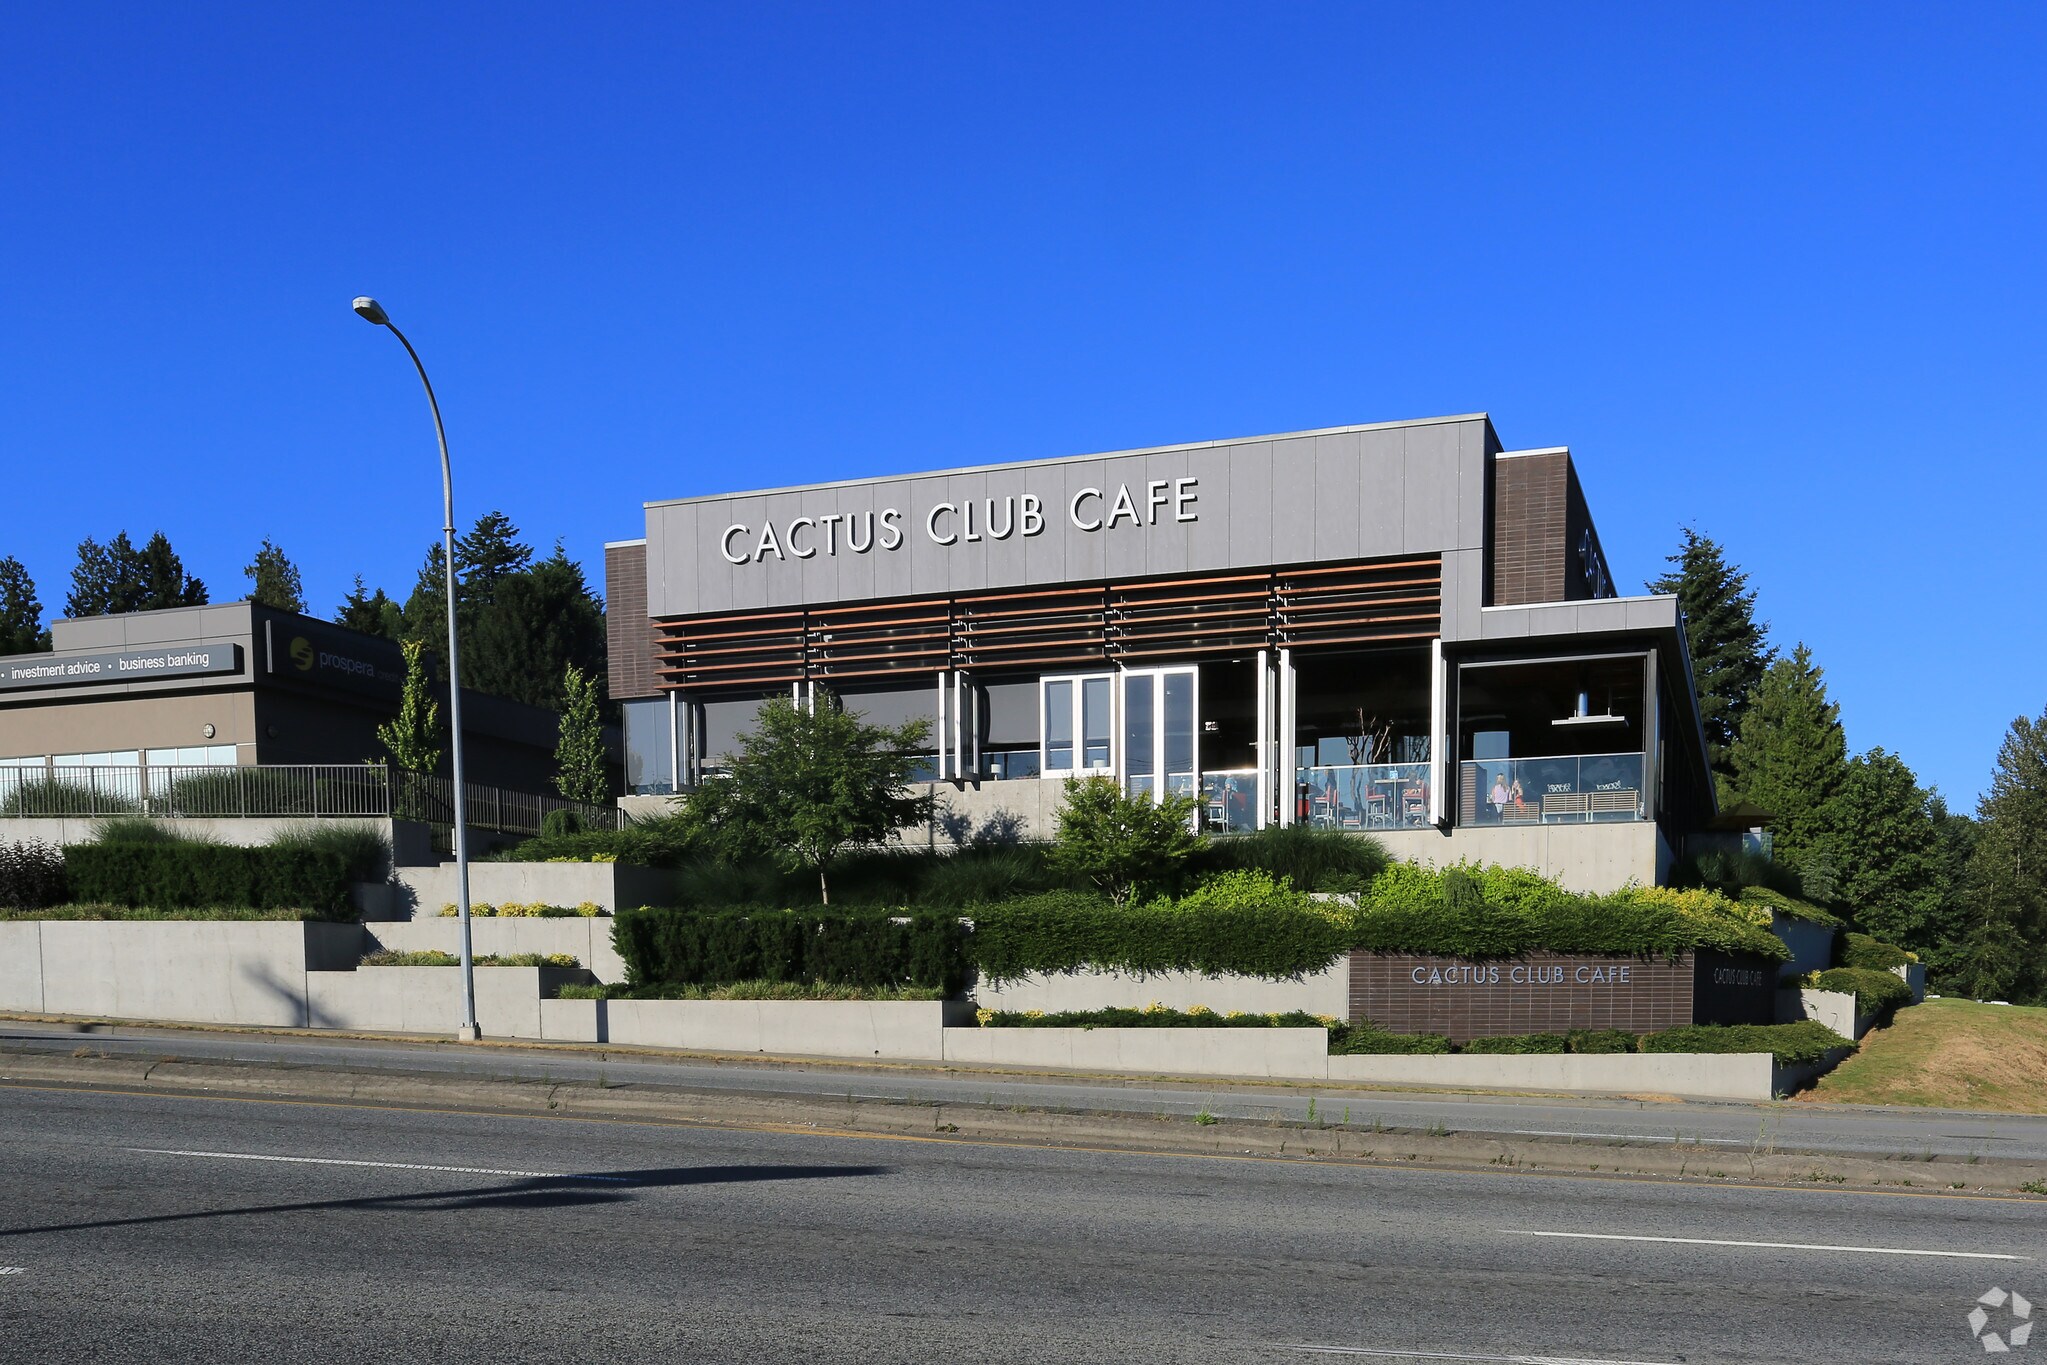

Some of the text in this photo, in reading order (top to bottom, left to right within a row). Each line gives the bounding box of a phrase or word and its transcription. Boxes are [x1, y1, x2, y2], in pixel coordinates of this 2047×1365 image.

[721, 476, 1199, 565] CACTUS CLUB CAFE
[11, 652, 209, 680] investment advice business banking
[319, 651, 374, 677] prospera
[1411, 966, 1630, 984] CACTUS CLUB CAFE
[1714, 967, 1736, 984] CACTUS
